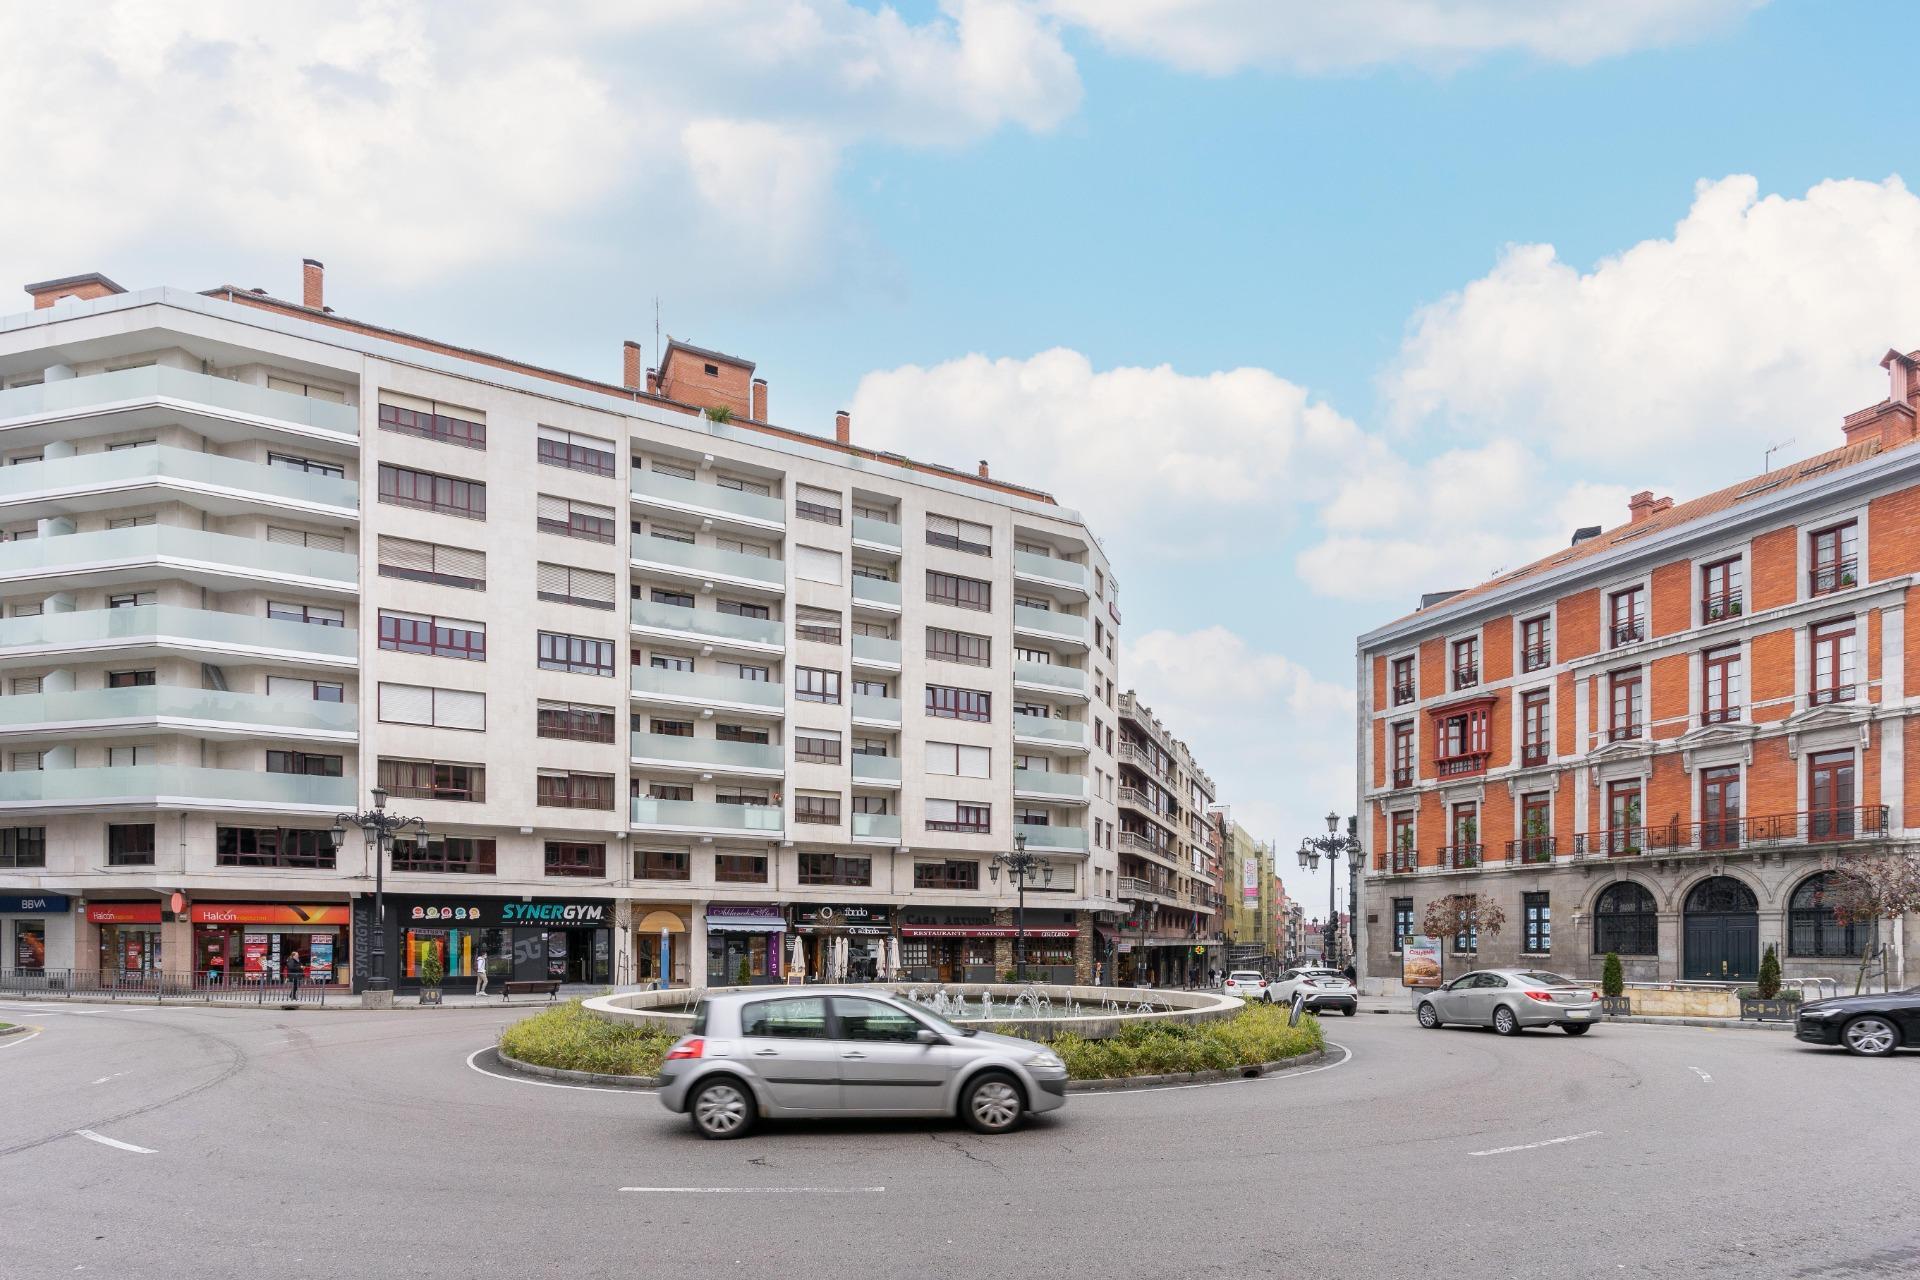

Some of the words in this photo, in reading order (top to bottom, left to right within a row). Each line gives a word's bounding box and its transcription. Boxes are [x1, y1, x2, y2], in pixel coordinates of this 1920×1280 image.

[21, 899, 46, 909] BBVA
[93, 911, 115, 920] Halcón
[203, 910, 236, 921] Halcón
[355, 909, 368, 977] SYNERGYM
